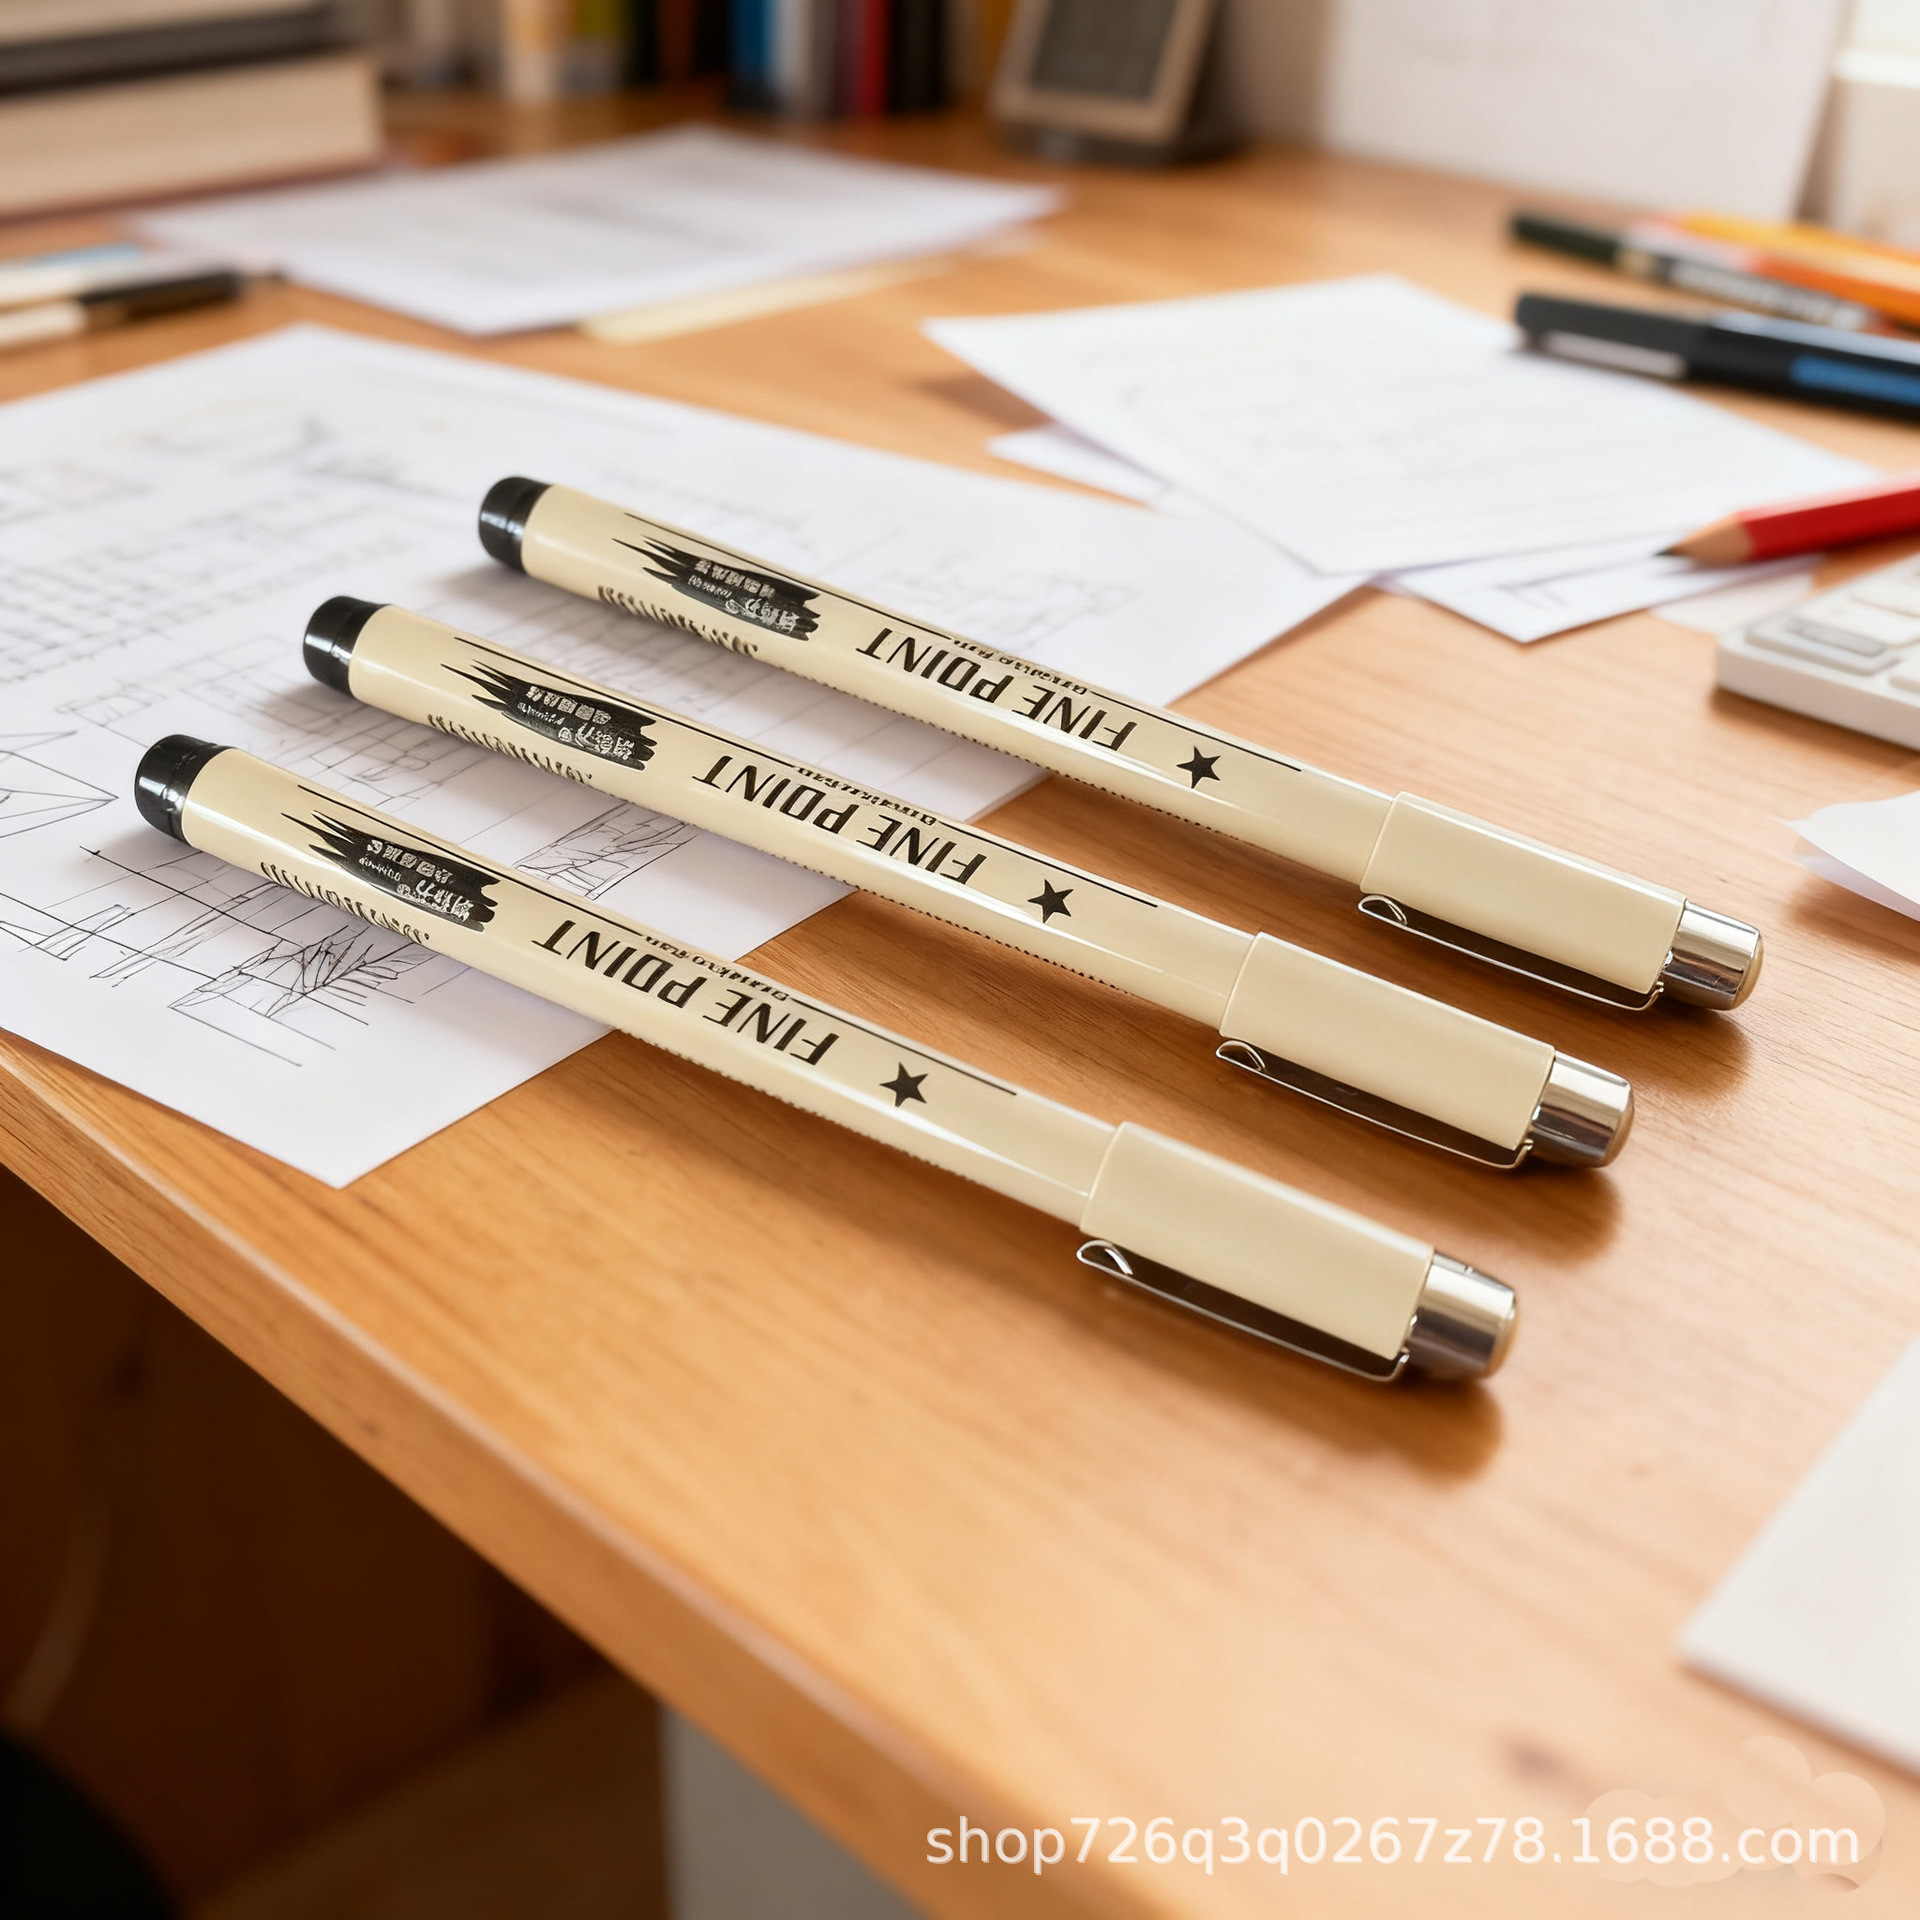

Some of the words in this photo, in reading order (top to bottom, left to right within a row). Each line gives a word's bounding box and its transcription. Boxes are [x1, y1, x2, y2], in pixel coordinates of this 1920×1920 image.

[855, 628, 1013, 703] POINT
[1012, 685, 1137, 751] FINE
[692, 755, 859, 834] POINT
[856, 815, 986, 885] FINE
[531, 920, 707, 1009] POINT
[703, 989, 839, 1065] FINE
